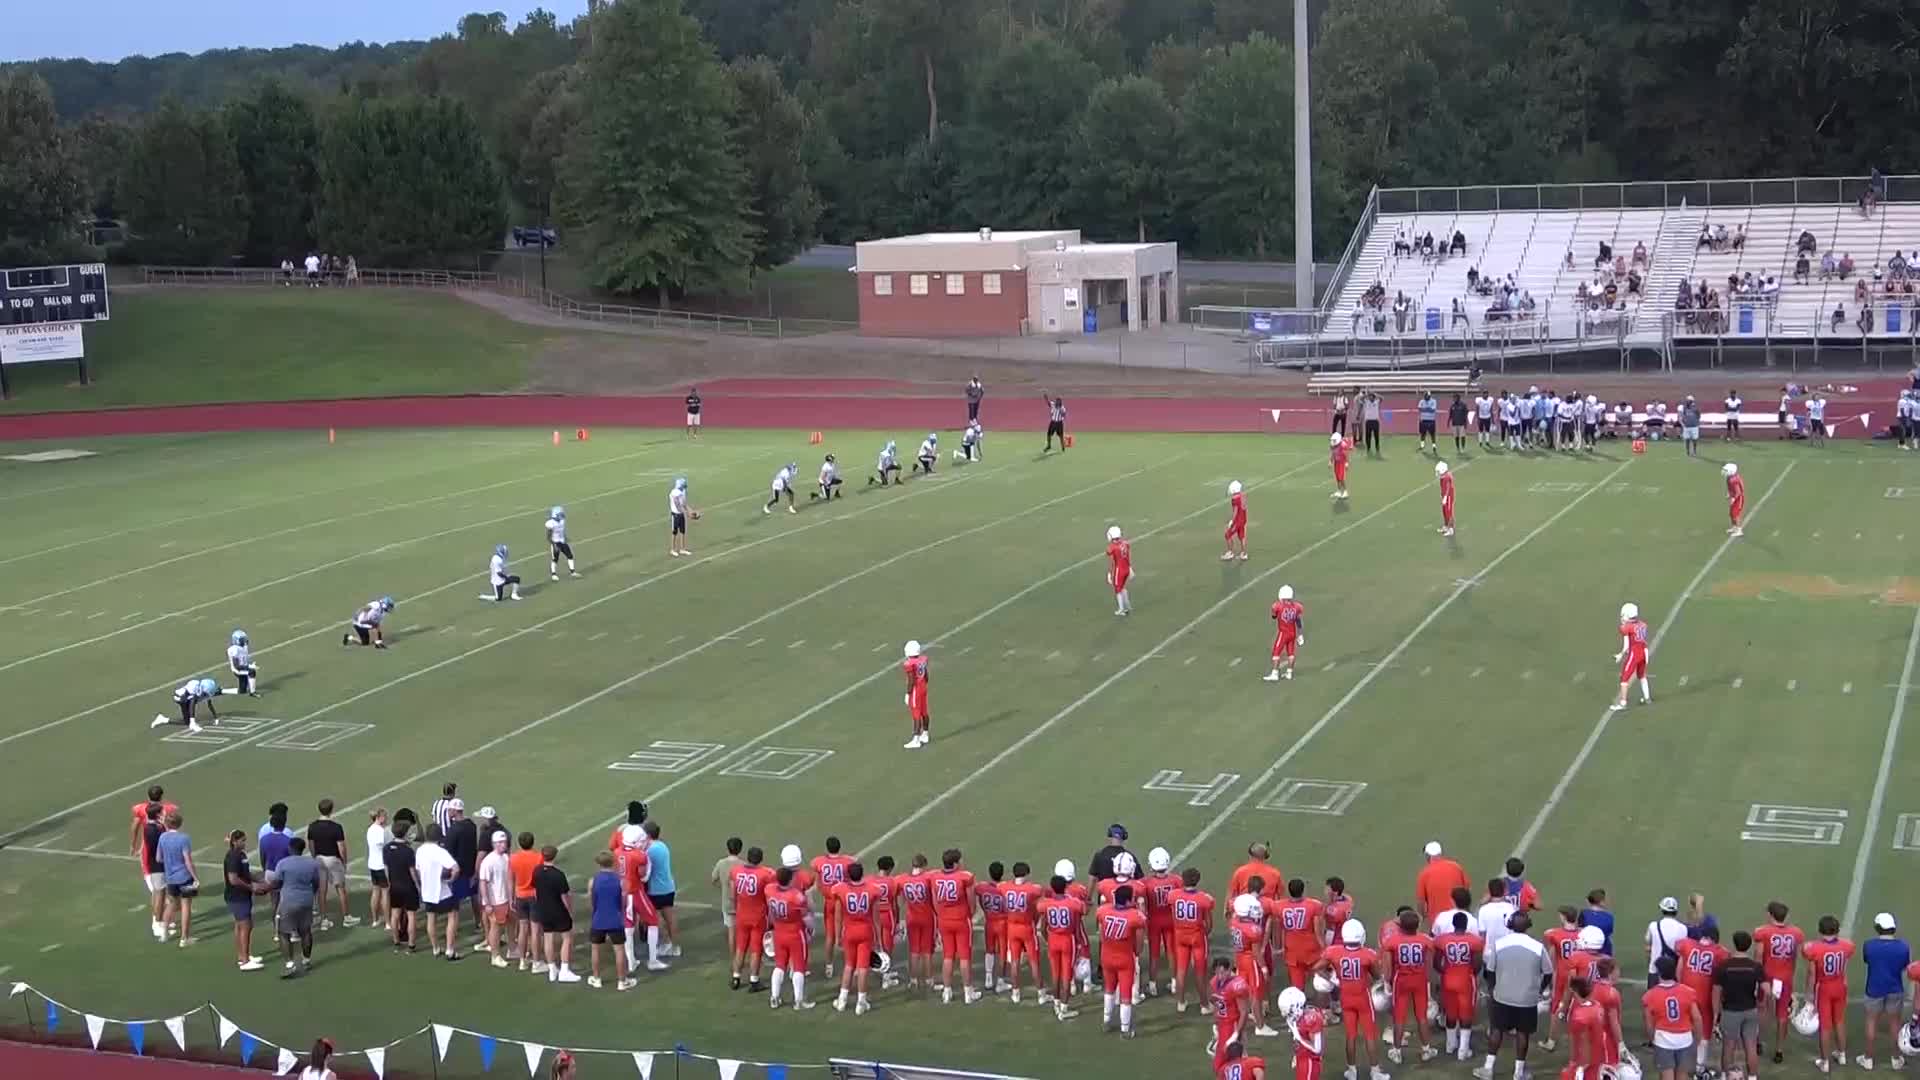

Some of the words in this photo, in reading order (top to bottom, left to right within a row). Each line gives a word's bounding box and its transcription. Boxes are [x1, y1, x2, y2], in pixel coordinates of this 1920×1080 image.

[79, 265, 103, 275] GUEST
[10, 299, 21, 308] TO
[22, 298, 34, 308] GO
[43, 296, 61, 306] BALL
[61, 295, 72, 305] ON
[80, 293, 96, 304] QTR
[736, 873, 758, 896] 73
[821, 864, 844, 885] 24
[904, 883, 926, 902] 63
[936, 880, 958, 902] 72
[1007, 891, 1027, 912] 84
[846, 891, 869, 914] 64
[1175, 900, 1197, 920] 80
[1047, 907, 1070, 928] 88
[1104, 917, 1128, 940] 77
[1398, 944, 1423, 964] 86
[1447, 943, 1470, 963] 92
[1770, 934, 1794, 957] 23
[1340, 957, 1361, 980] 21
[1687, 948, 1714, 974] 42
[1823, 951, 1846, 977] 81
[1665, 996, 1681, 1022] 8
